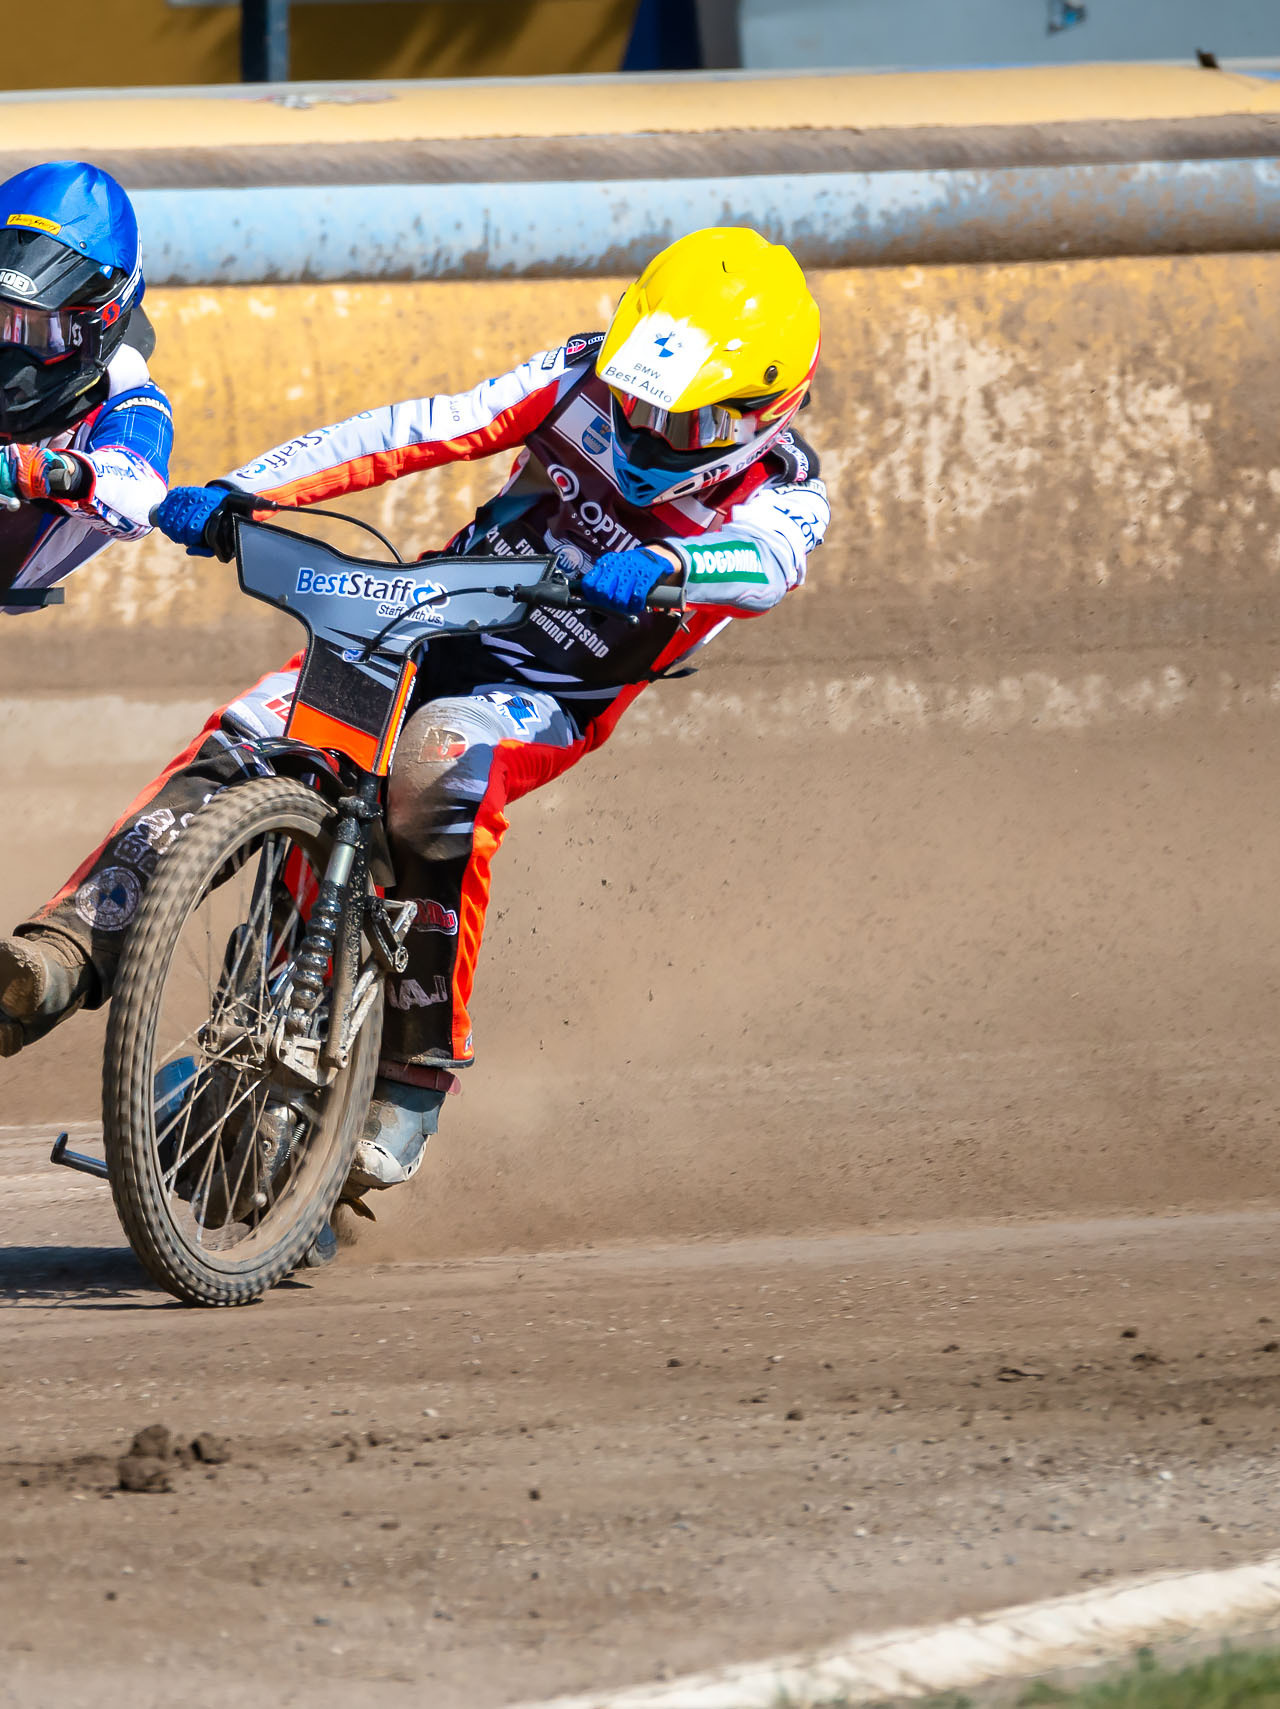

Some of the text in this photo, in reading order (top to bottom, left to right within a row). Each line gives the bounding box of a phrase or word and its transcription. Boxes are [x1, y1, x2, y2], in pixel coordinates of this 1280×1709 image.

[604, 366, 672, 403] Best Auto
[633, 362, 661, 379] BMW
[296, 568, 414, 601] BestStaff
[528, 608, 575, 651] Round 1
